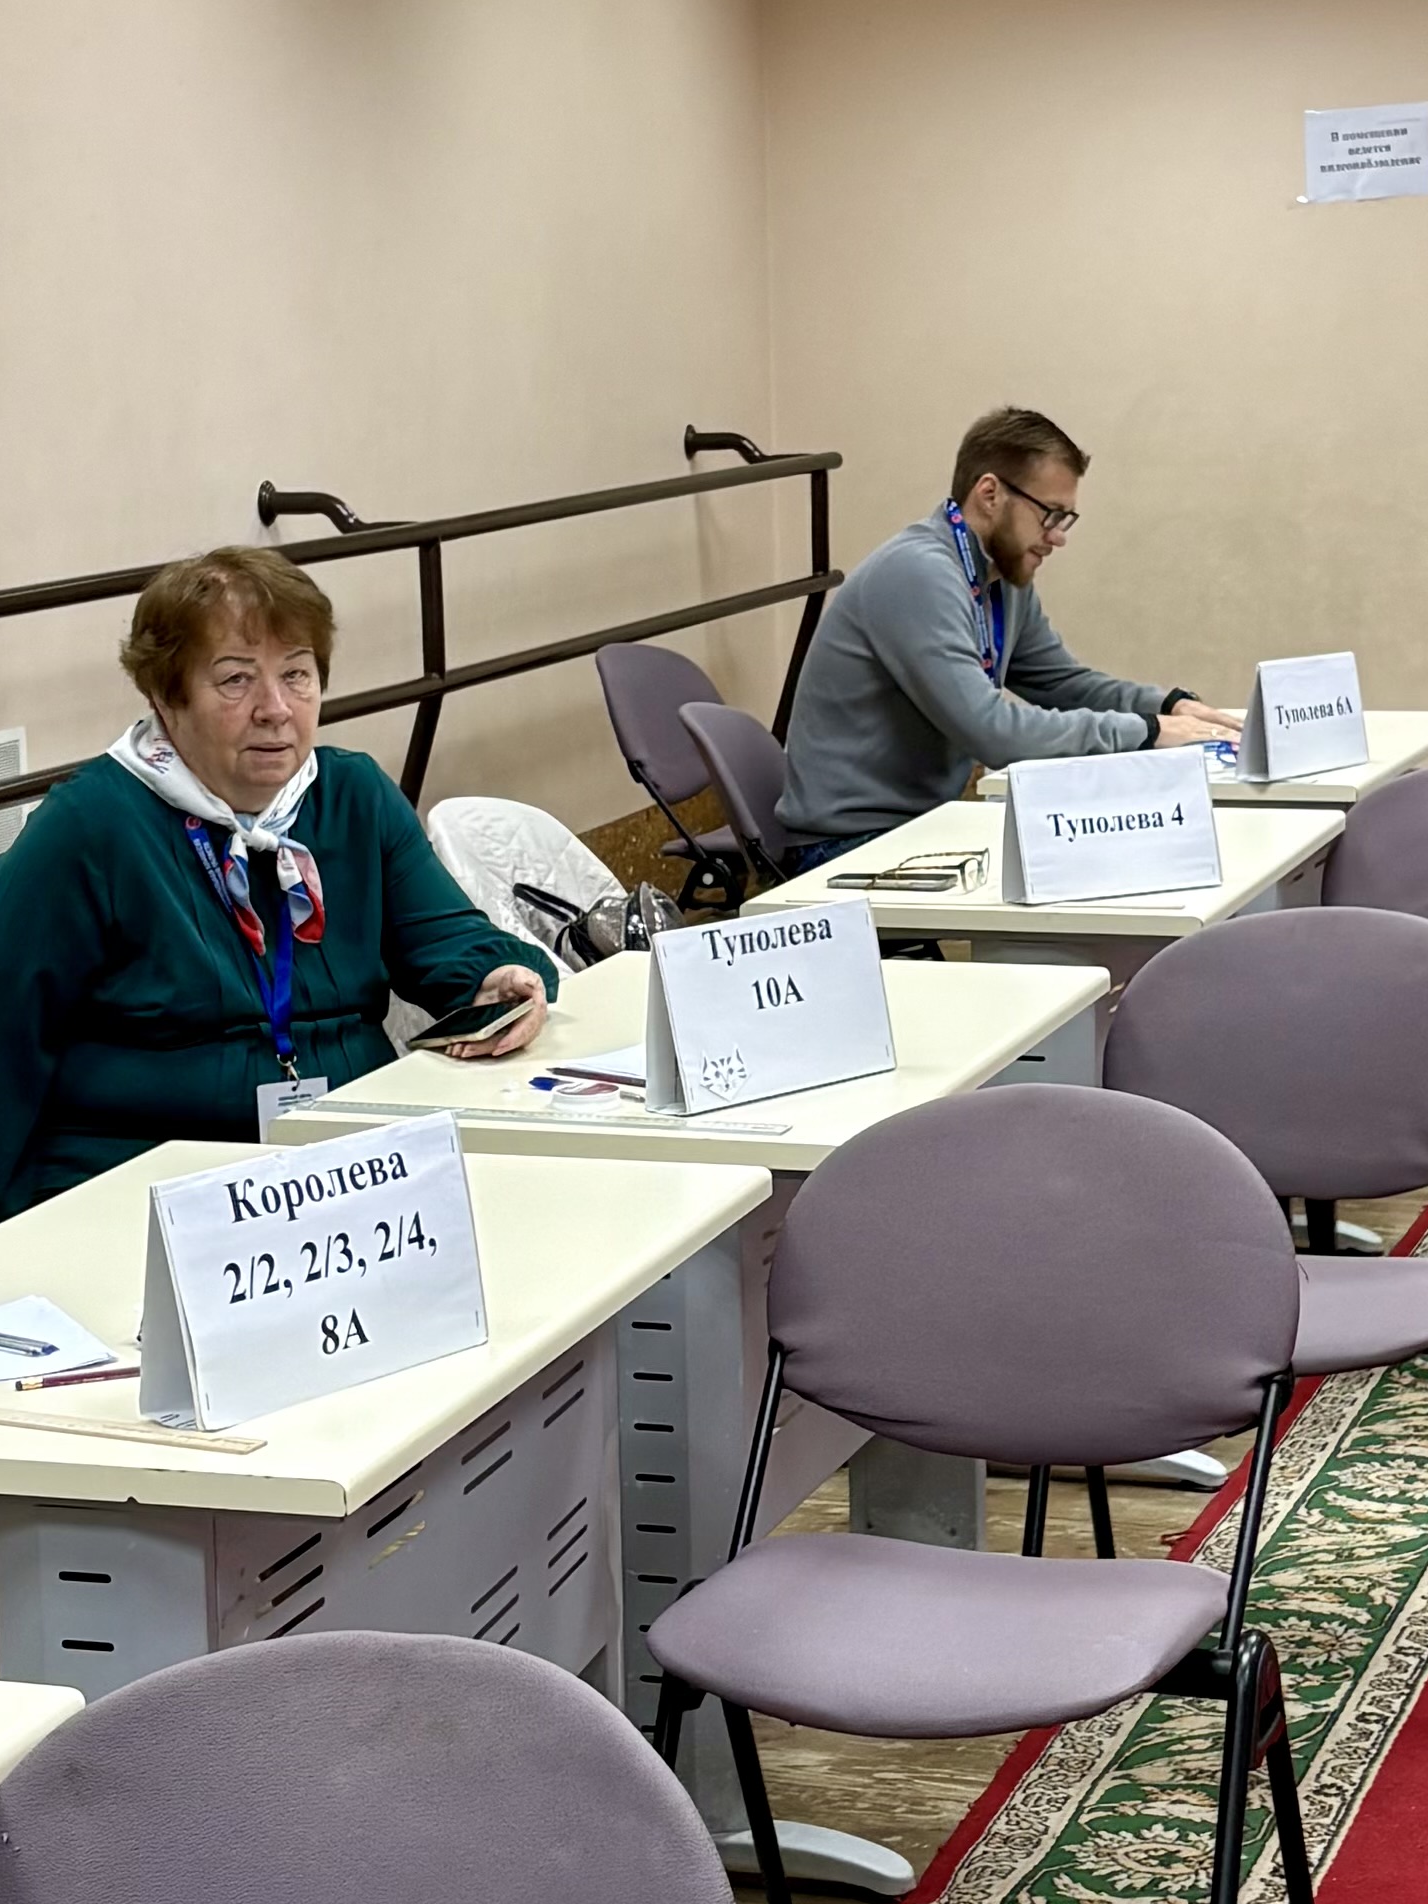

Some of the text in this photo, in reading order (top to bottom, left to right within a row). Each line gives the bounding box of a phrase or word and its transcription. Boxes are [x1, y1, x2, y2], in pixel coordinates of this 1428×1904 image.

[1275, 695, 1353, 730] Туполева 6А
[1046, 802, 1184, 843] Туполева 4
[701, 917, 833, 967] Туполева
[752, 973, 805, 1010] 10А
[224, 1151, 409, 1223] Королева
[223, 1210, 437, 1304] 2/2, 2/3, 2/4,
[320, 1307, 370, 1355] 8А
